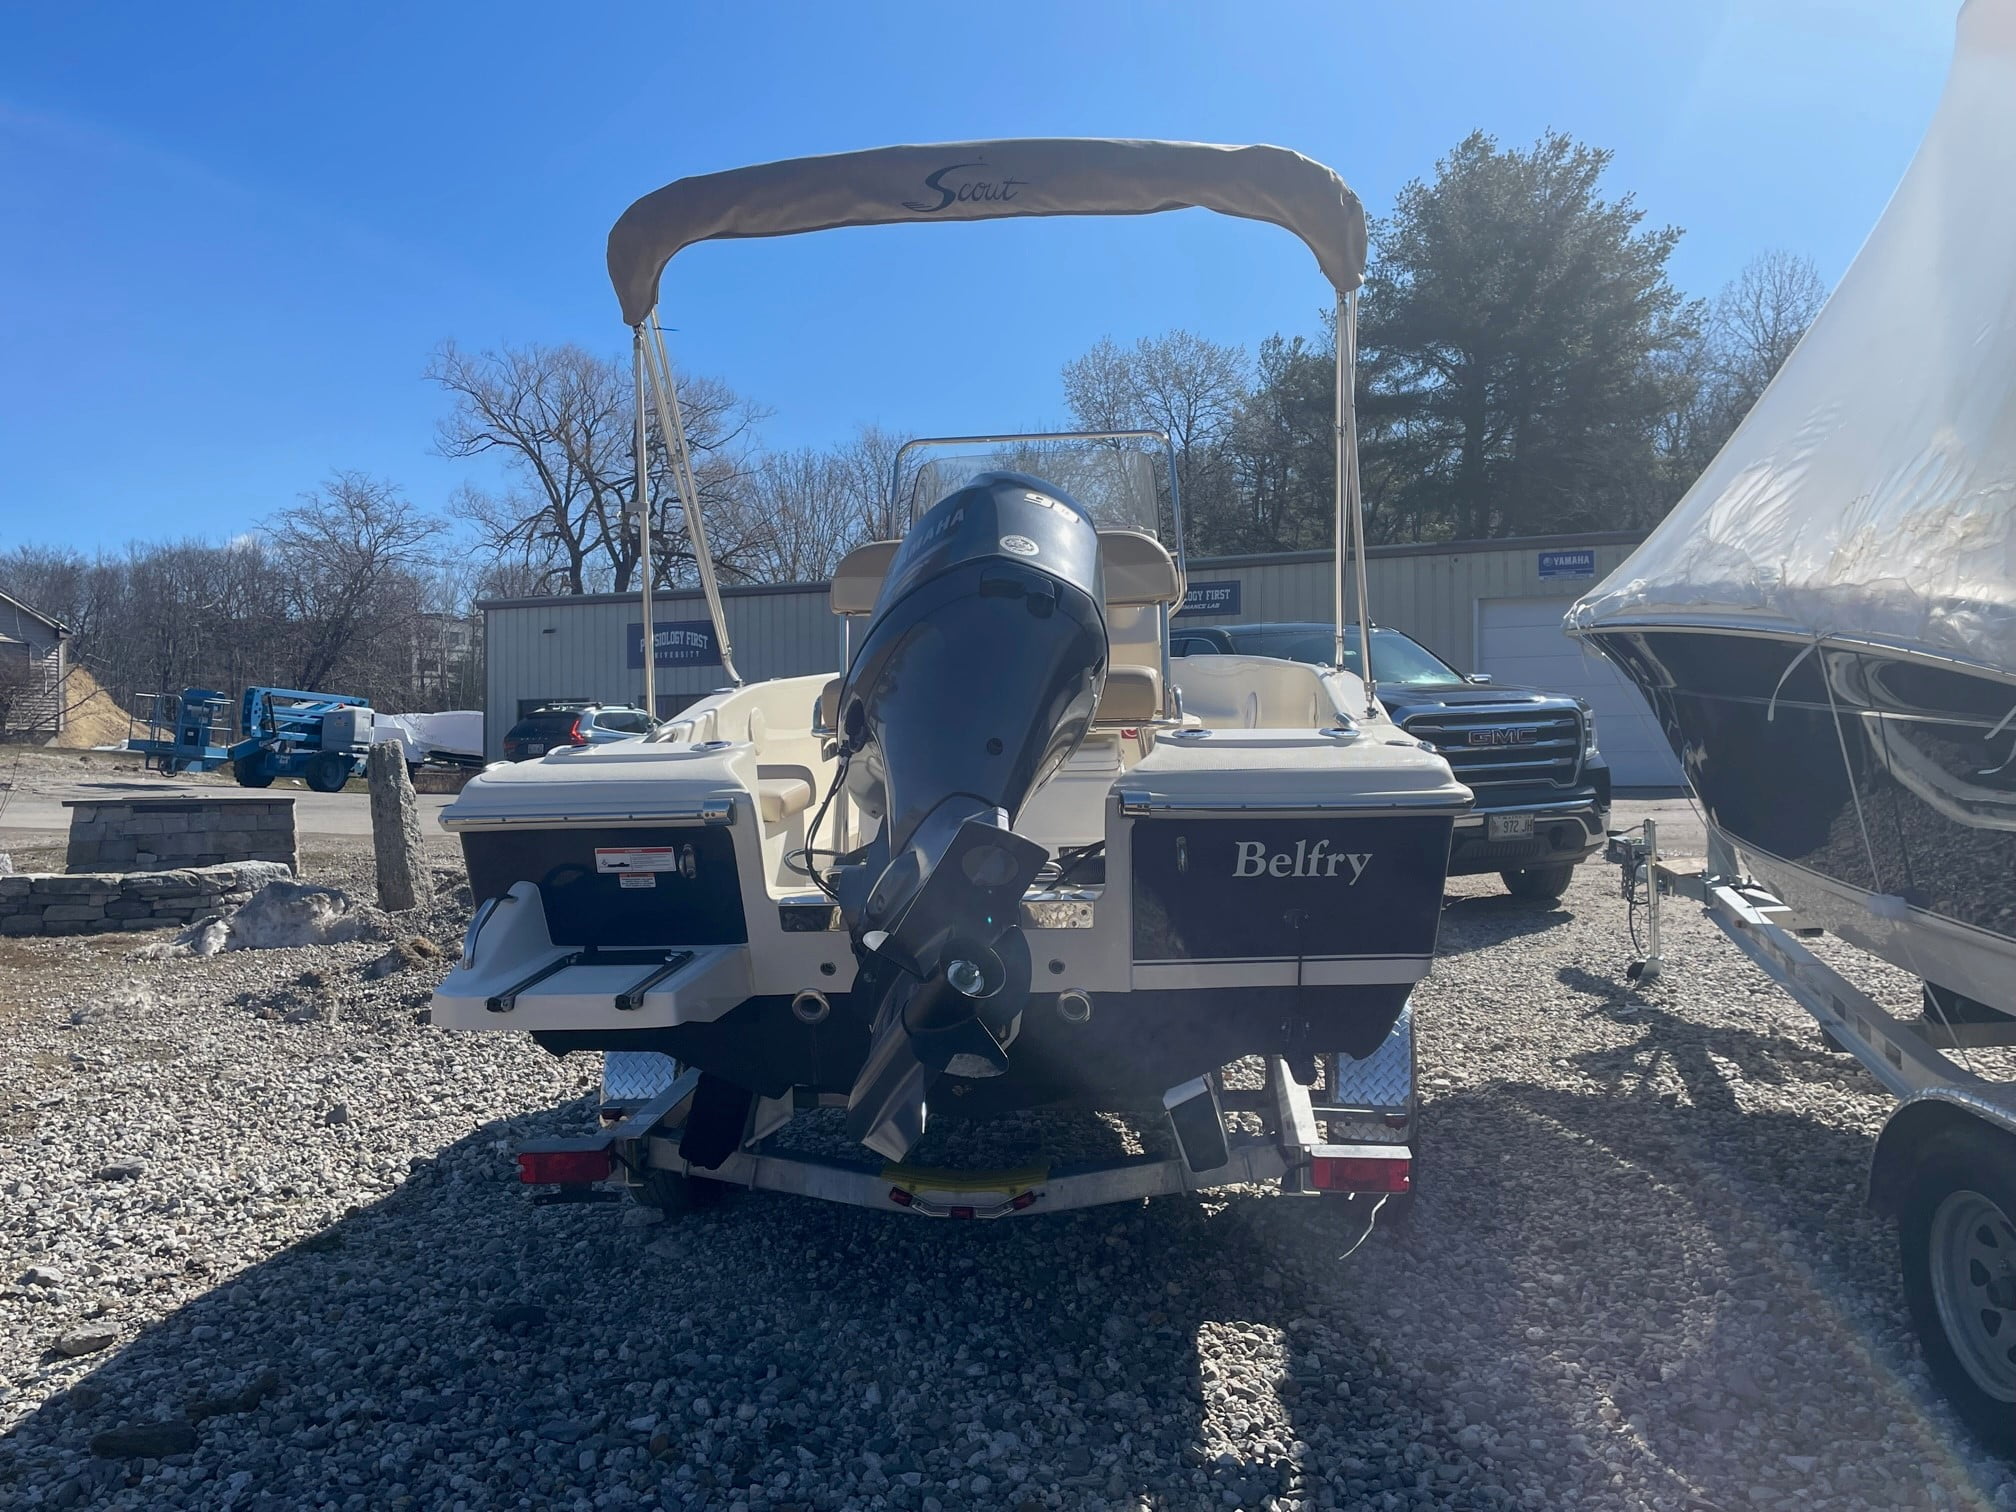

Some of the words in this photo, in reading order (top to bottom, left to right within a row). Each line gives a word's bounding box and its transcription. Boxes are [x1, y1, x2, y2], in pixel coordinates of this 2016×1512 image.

[902, 163, 1029, 212] Scout
[1553, 555, 1590, 566] YAMAHA
[1206, 589, 1230, 600] FIRST
[640, 630, 684, 652] PSIOLOGY
[686, 631, 708, 650] FIRST
[1468, 727, 1537, 745] GMC
[1503, 820, 1519, 833] 972
[1232, 839, 1373, 886] Belfry
